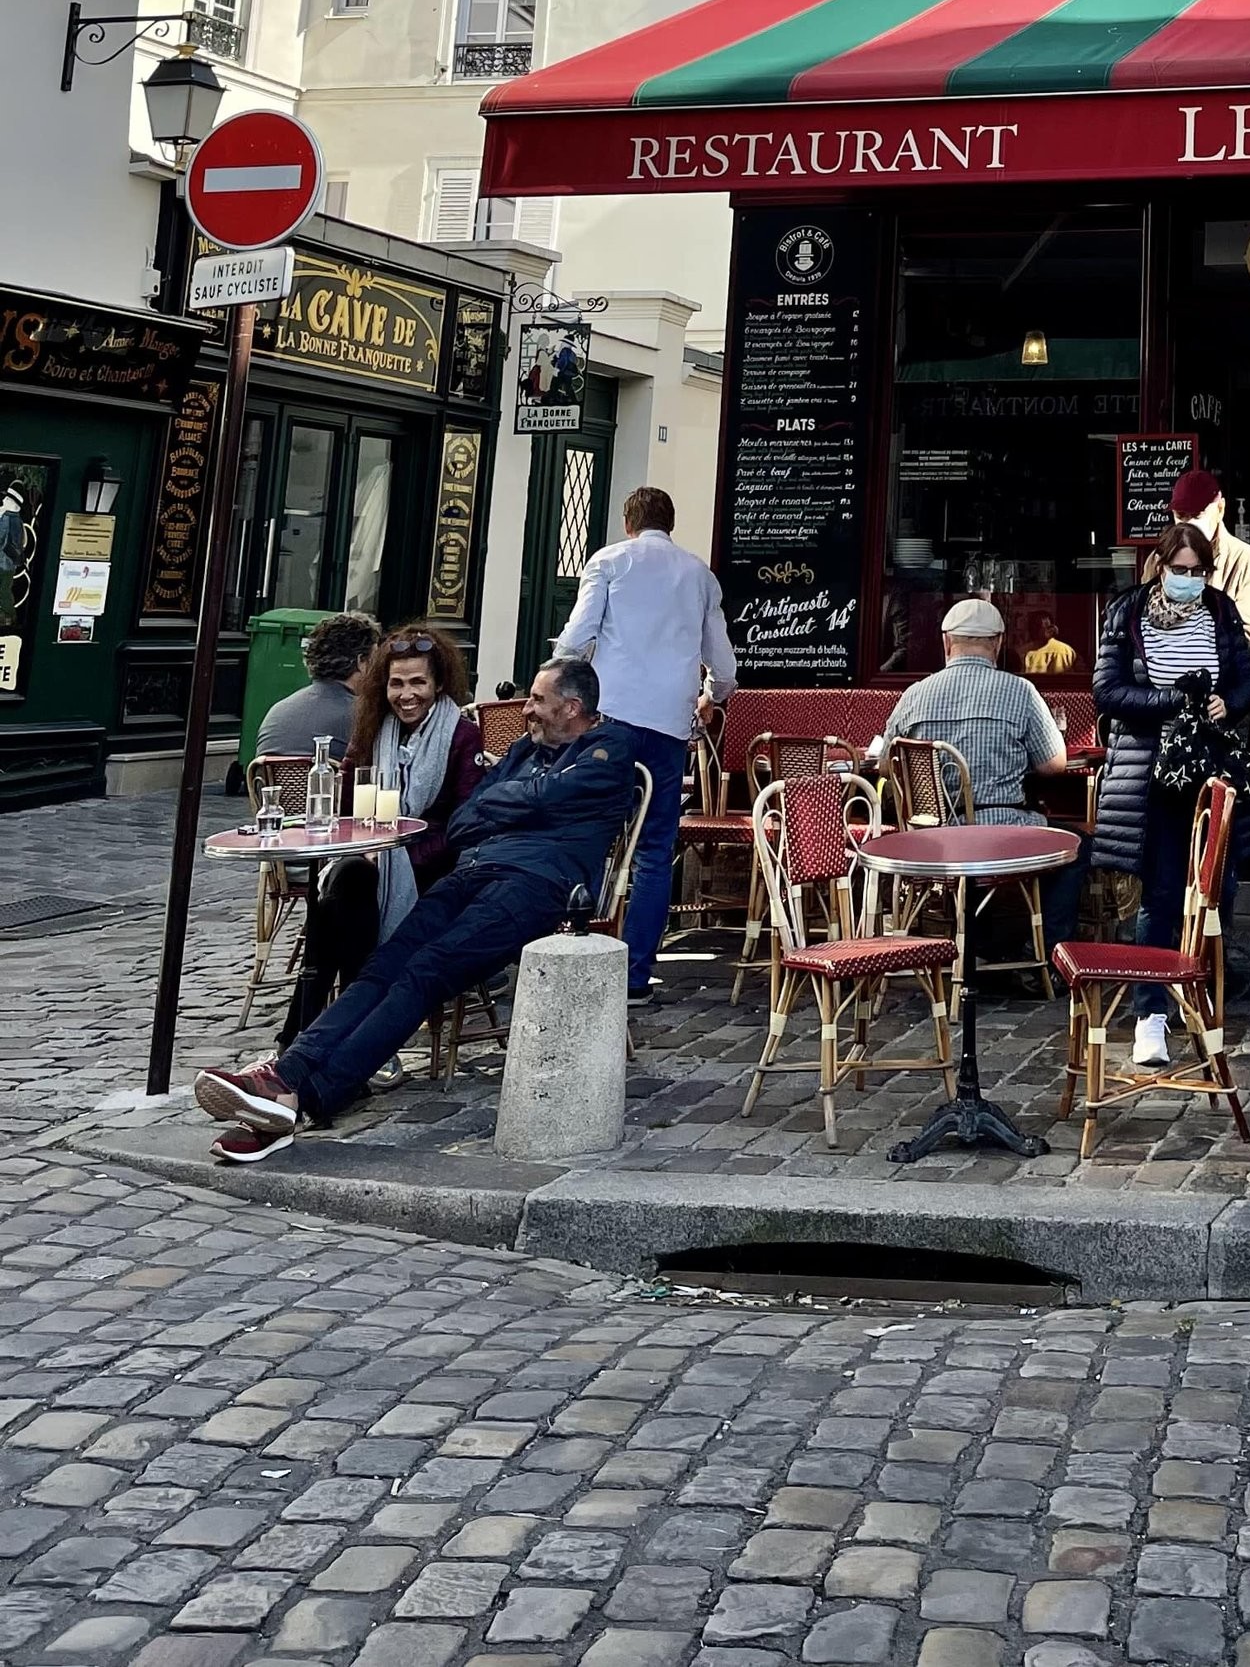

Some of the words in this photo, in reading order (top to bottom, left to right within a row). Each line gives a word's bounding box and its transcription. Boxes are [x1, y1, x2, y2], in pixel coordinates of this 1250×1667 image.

[626, 122, 1018, 180] RESTAURANT
[806, 229, 813, 237] &
[213, 259, 264, 279] INTERDIT
[194, 284, 223, 301] SAUF
[227, 277, 279, 297] CYCLISTE
[279, 292, 303, 322] LA
[307, 288, 389, 348] CAVE
[392, 314, 418, 347] DE
[275, 324, 296, 349] LA
[298, 330, 338, 356] BONNE
[338, 338, 413, 374] FRANQUETTE
[527, 408, 538, 418] LA
[542, 408, 572, 418] BONNE
[520, 417, 577, 428] FRANQUETTE
[776, 418, 816, 432] PLATS
[1122, 442, 1138, 452] LES
[1165, 440, 1192, 451] CARTE
[1152, 455, 1164, 466] de
[746, 616, 818, 644] Consulat
